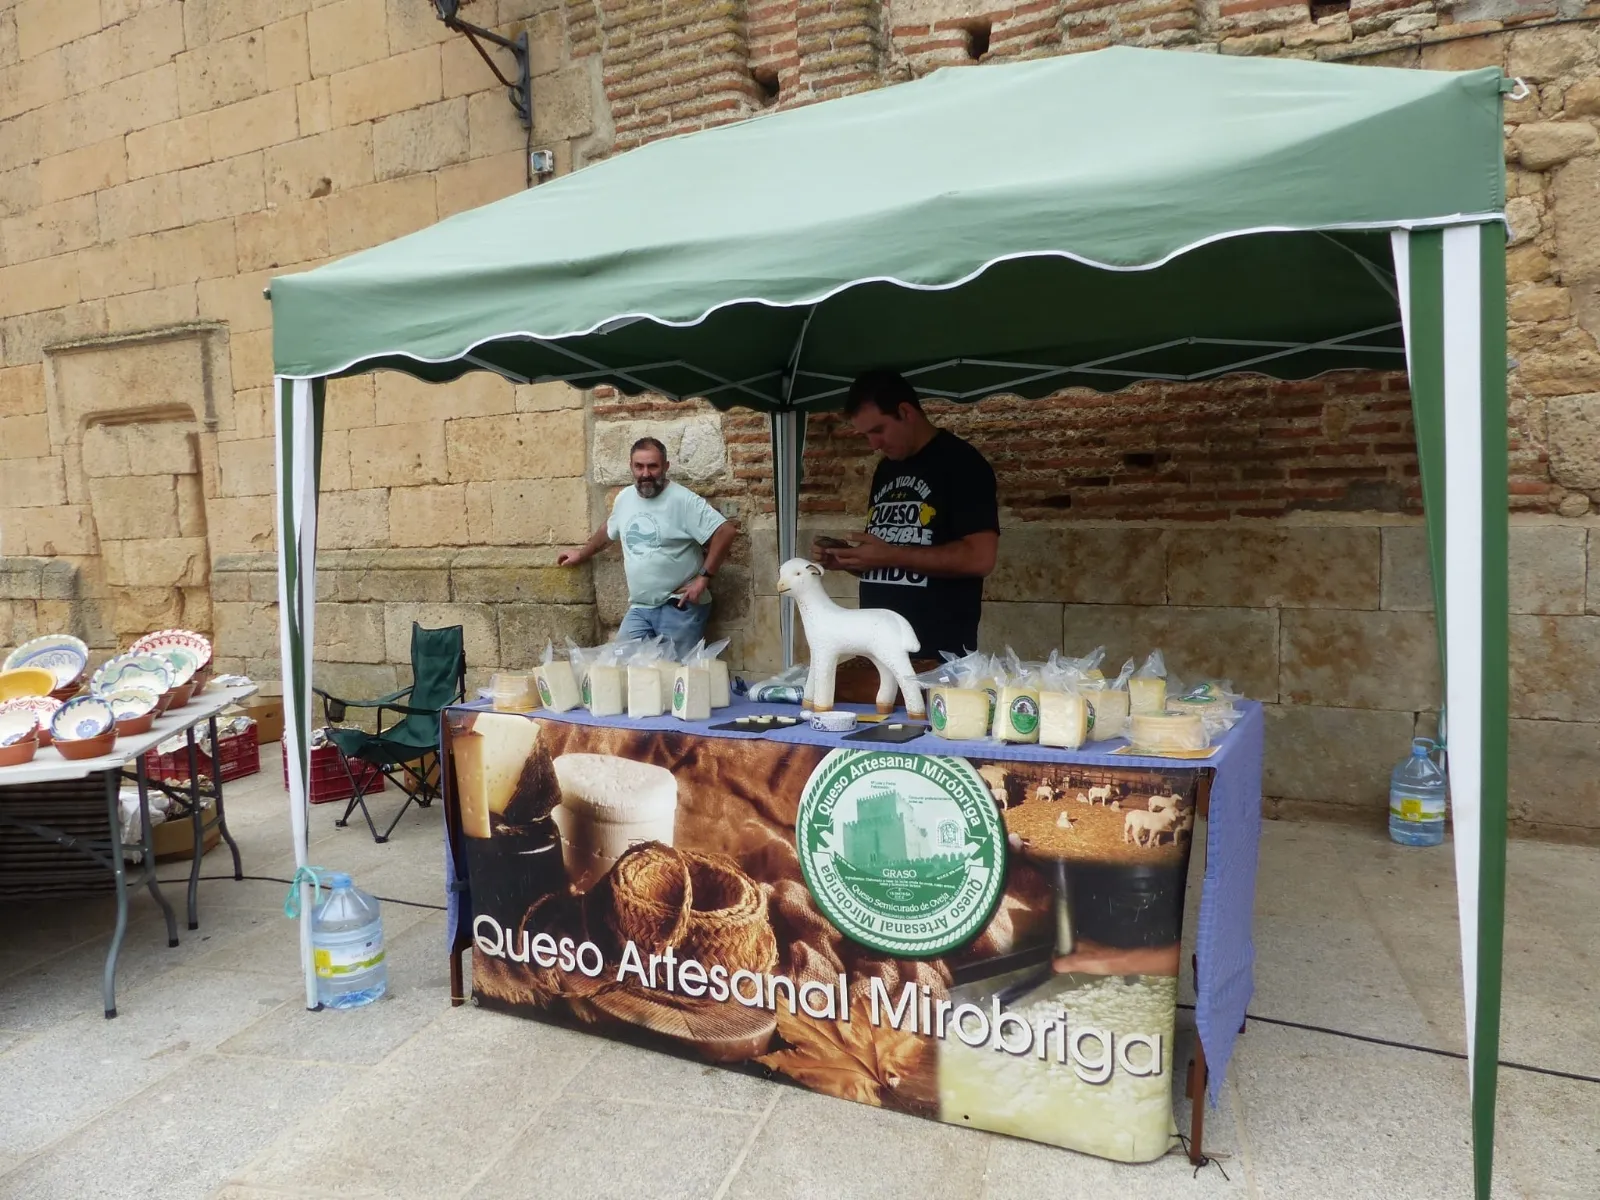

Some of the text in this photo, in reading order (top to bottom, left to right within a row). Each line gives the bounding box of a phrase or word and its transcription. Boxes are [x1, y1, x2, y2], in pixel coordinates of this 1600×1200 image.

[873, 475, 932, 503] UNA VIDA SIN
[869, 503, 919, 526] QUESO
[817, 757, 981, 827] Queso Artesanal Miróbriga
[882, 868, 917, 879] GRASO
[820, 864, 876, 930] Miróbriga
[851, 884, 874, 903] Queso
[873, 899, 919, 912] Semicurado
[920, 902, 930, 911] de
[929, 892, 950, 908] Oveja
[951, 878, 983, 918] Queso
[880, 915, 949, 934] Artesanal
[472, 914, 1163, 1085] Queso Artesanal Mirobriga
